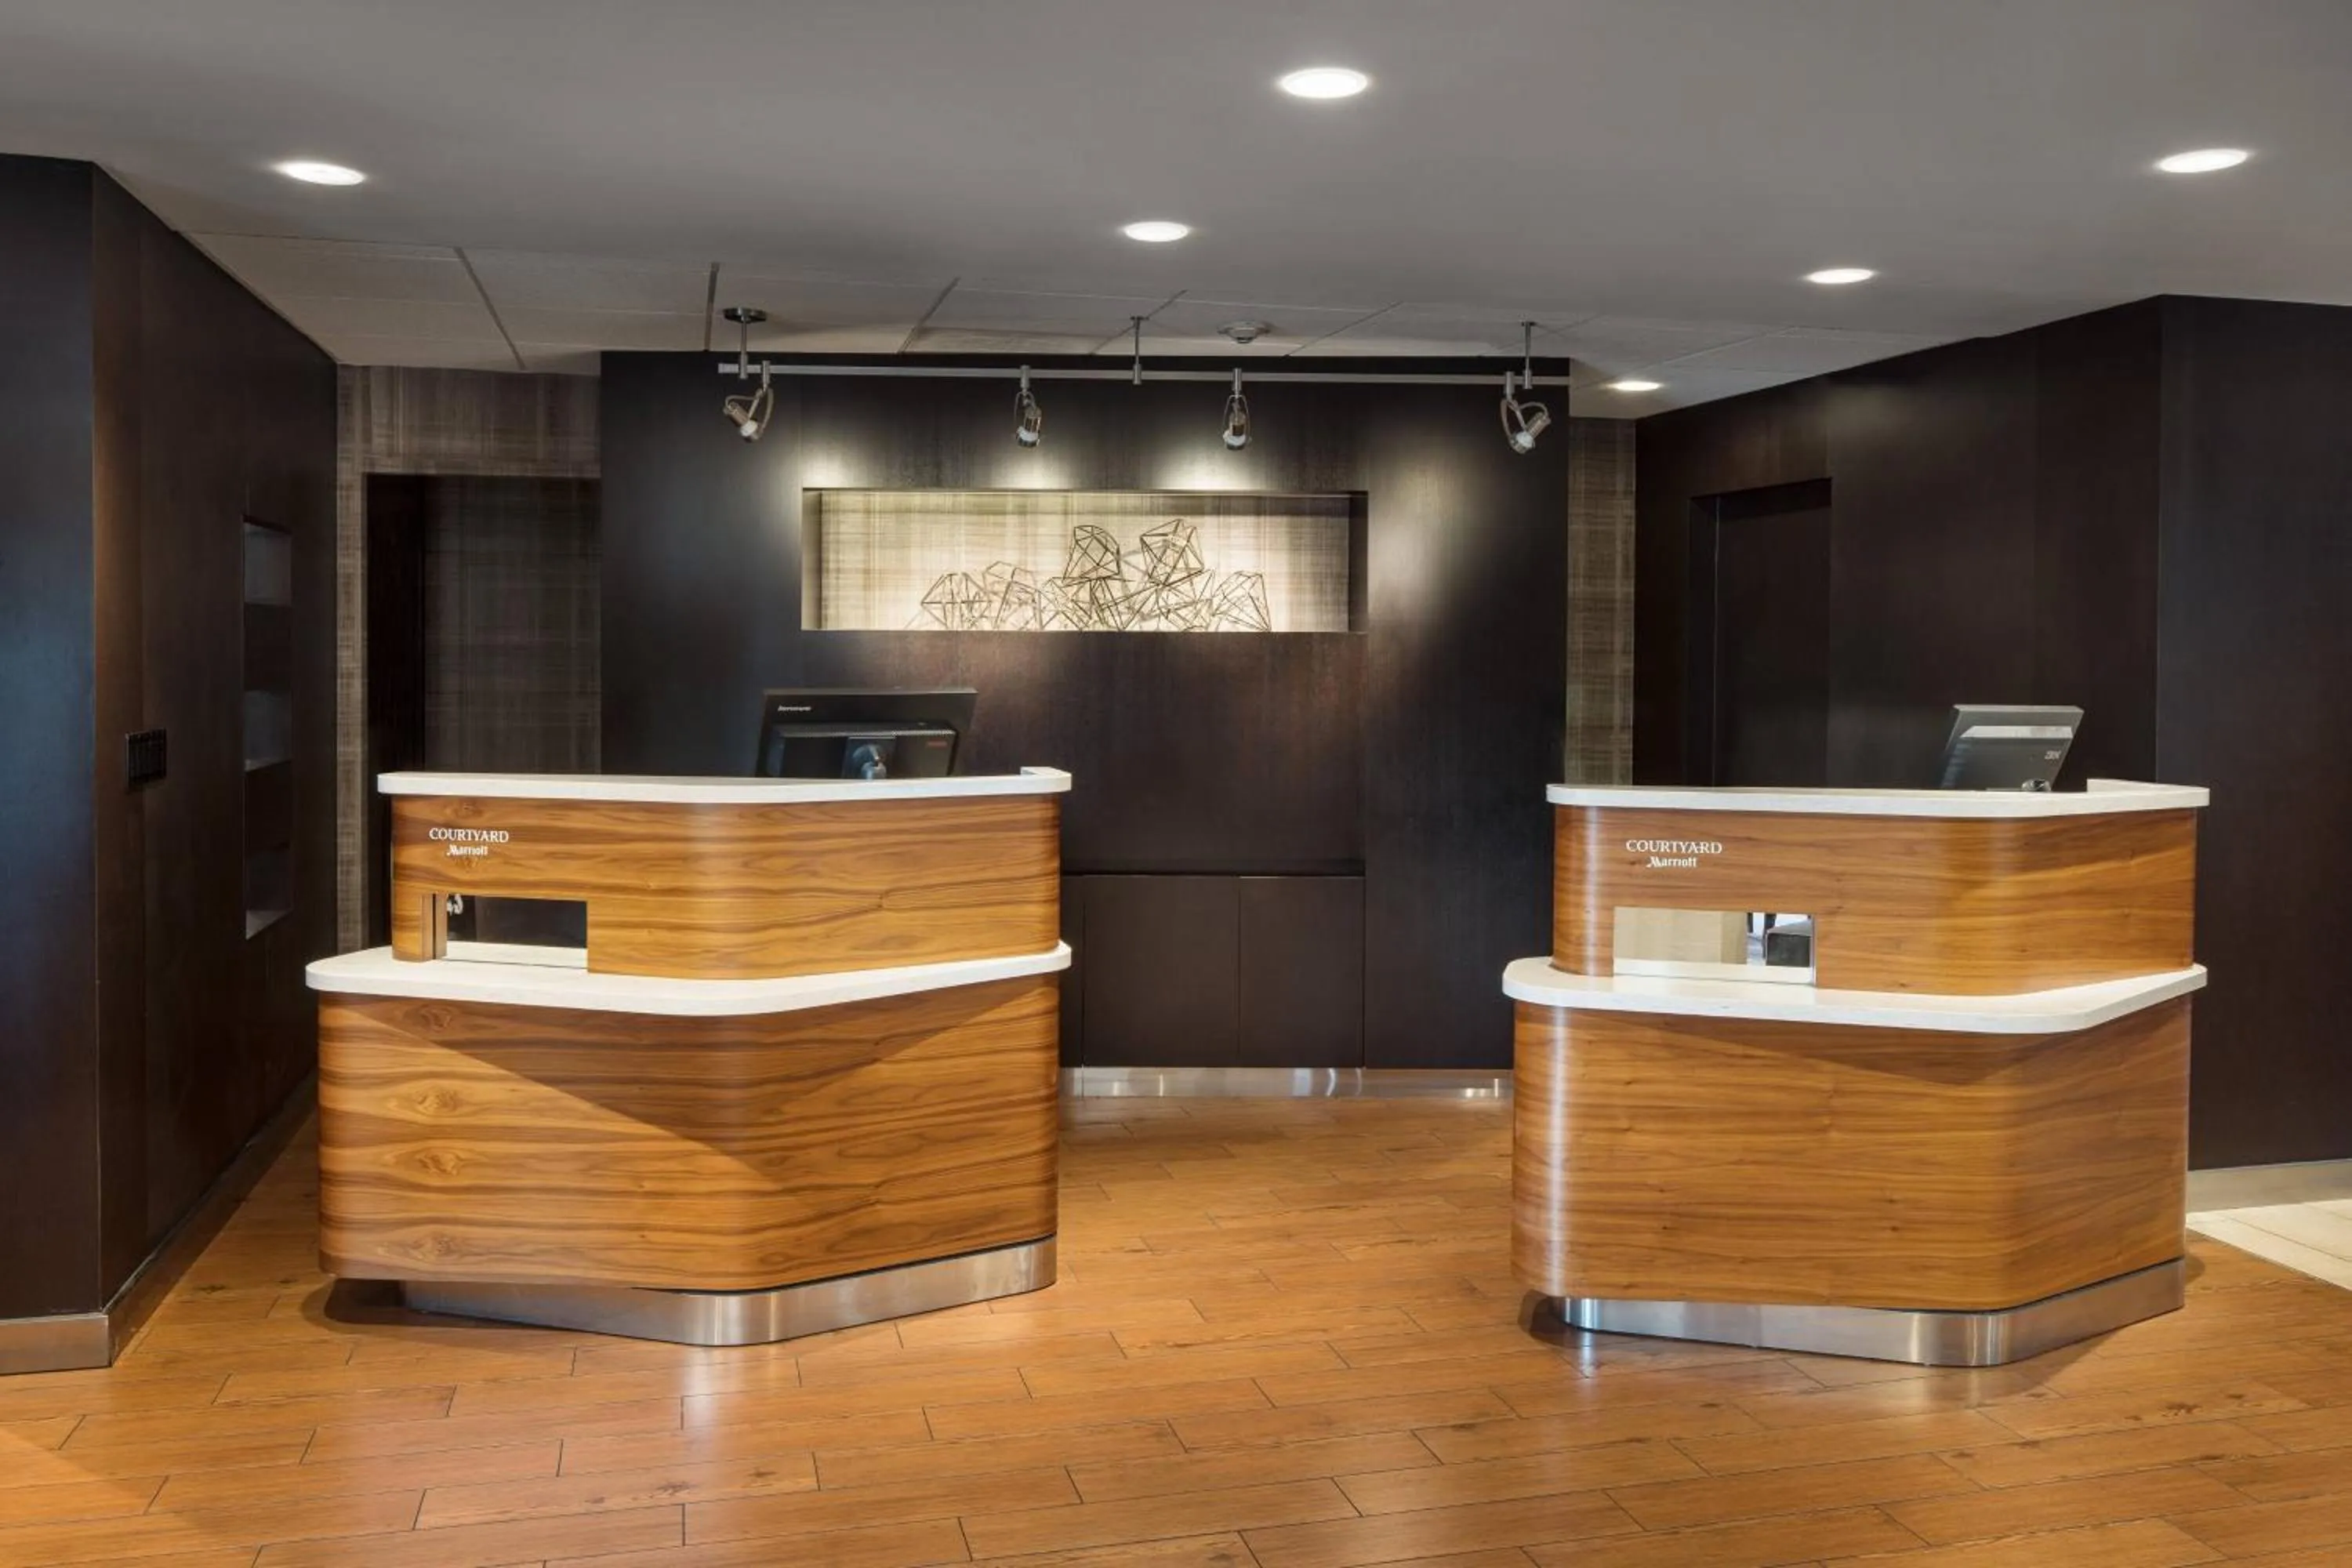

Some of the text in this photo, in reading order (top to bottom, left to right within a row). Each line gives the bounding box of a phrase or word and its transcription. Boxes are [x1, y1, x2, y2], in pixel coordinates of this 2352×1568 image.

[429, 827, 509, 843] COURTYARD
[446, 844, 488, 856] Marriott
[1625, 840, 1722, 854] COURTYARD
[1646, 855, 1697, 868] Marriott
